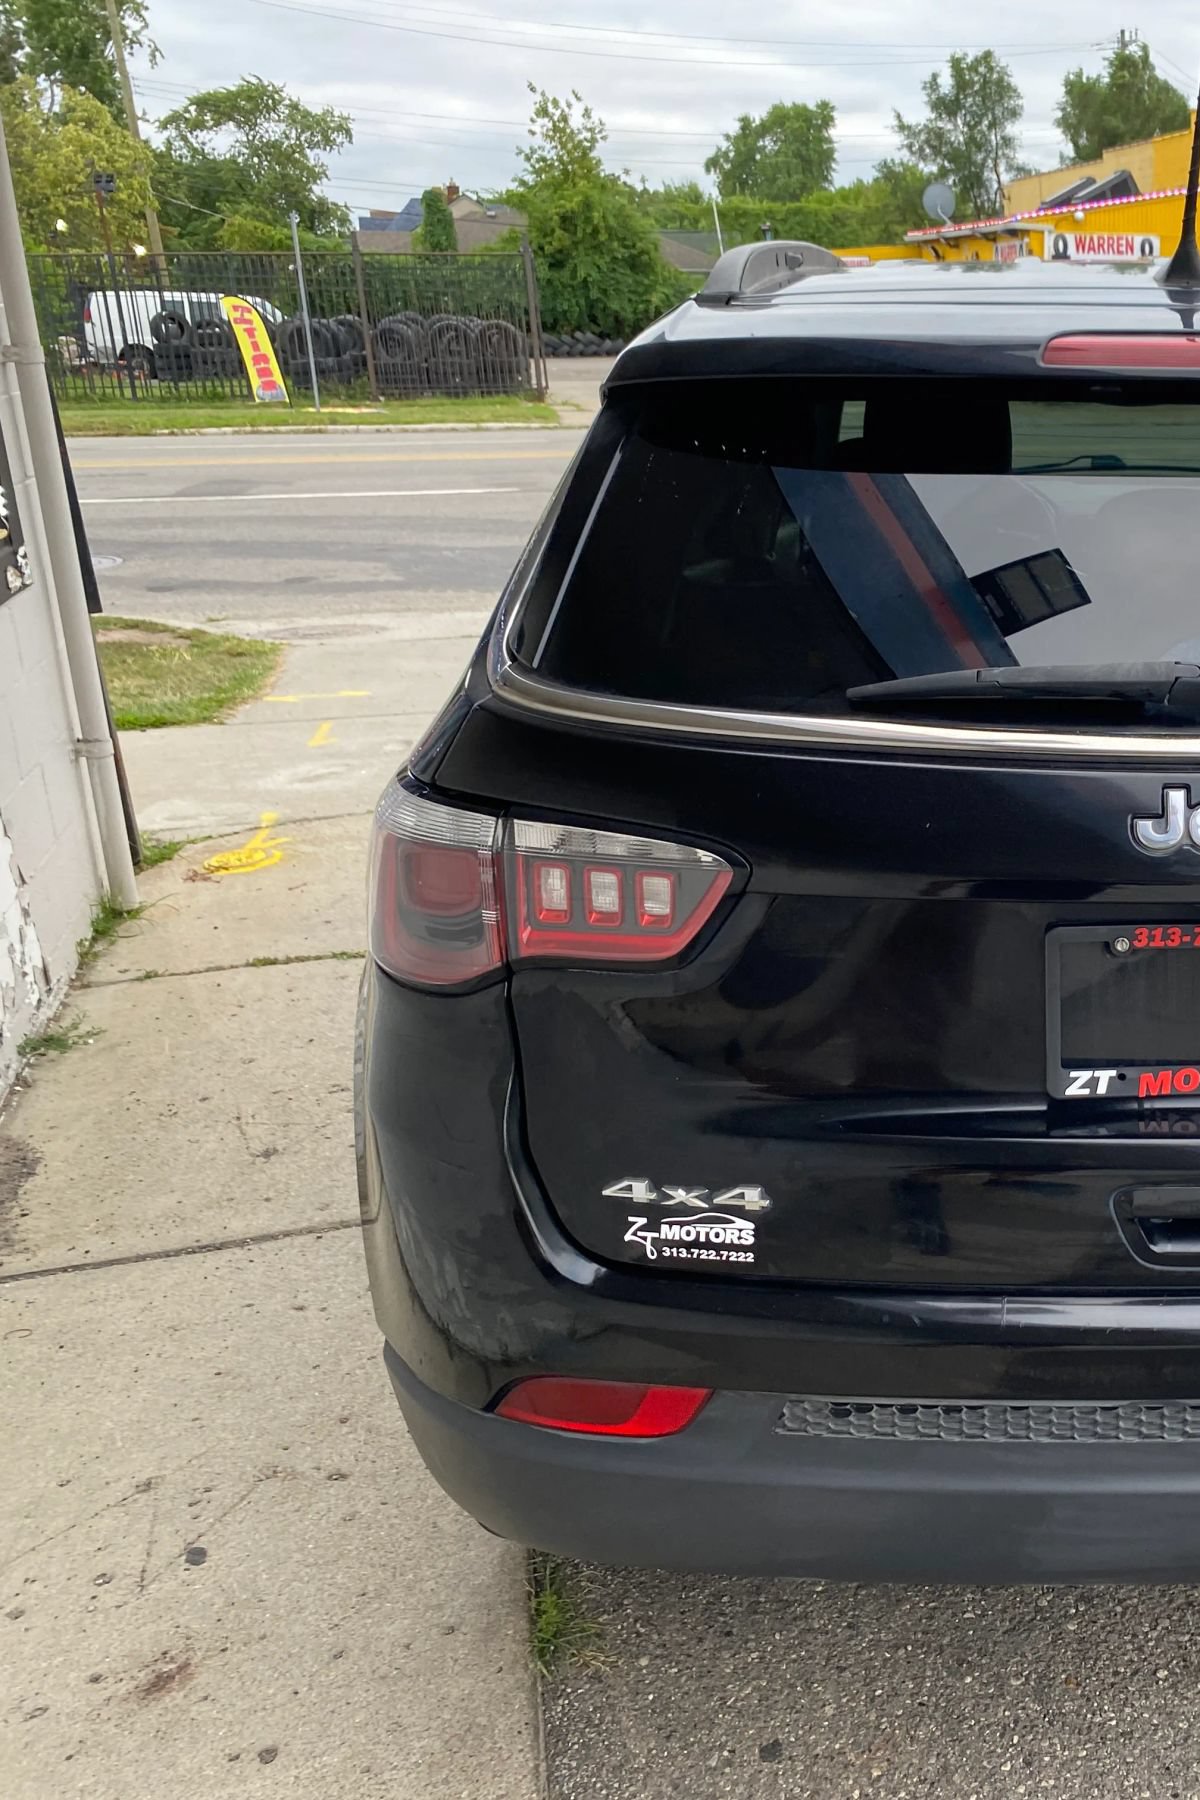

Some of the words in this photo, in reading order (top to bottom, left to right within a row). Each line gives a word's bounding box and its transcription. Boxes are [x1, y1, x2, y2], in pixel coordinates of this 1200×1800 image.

[1074, 234, 1135, 256] WARREN
[1064, 1070, 1117, 1096] ZT
[660, 1224, 756, 1246] MOTORS
[661, 1246, 755, 1263] 313.722.7222
